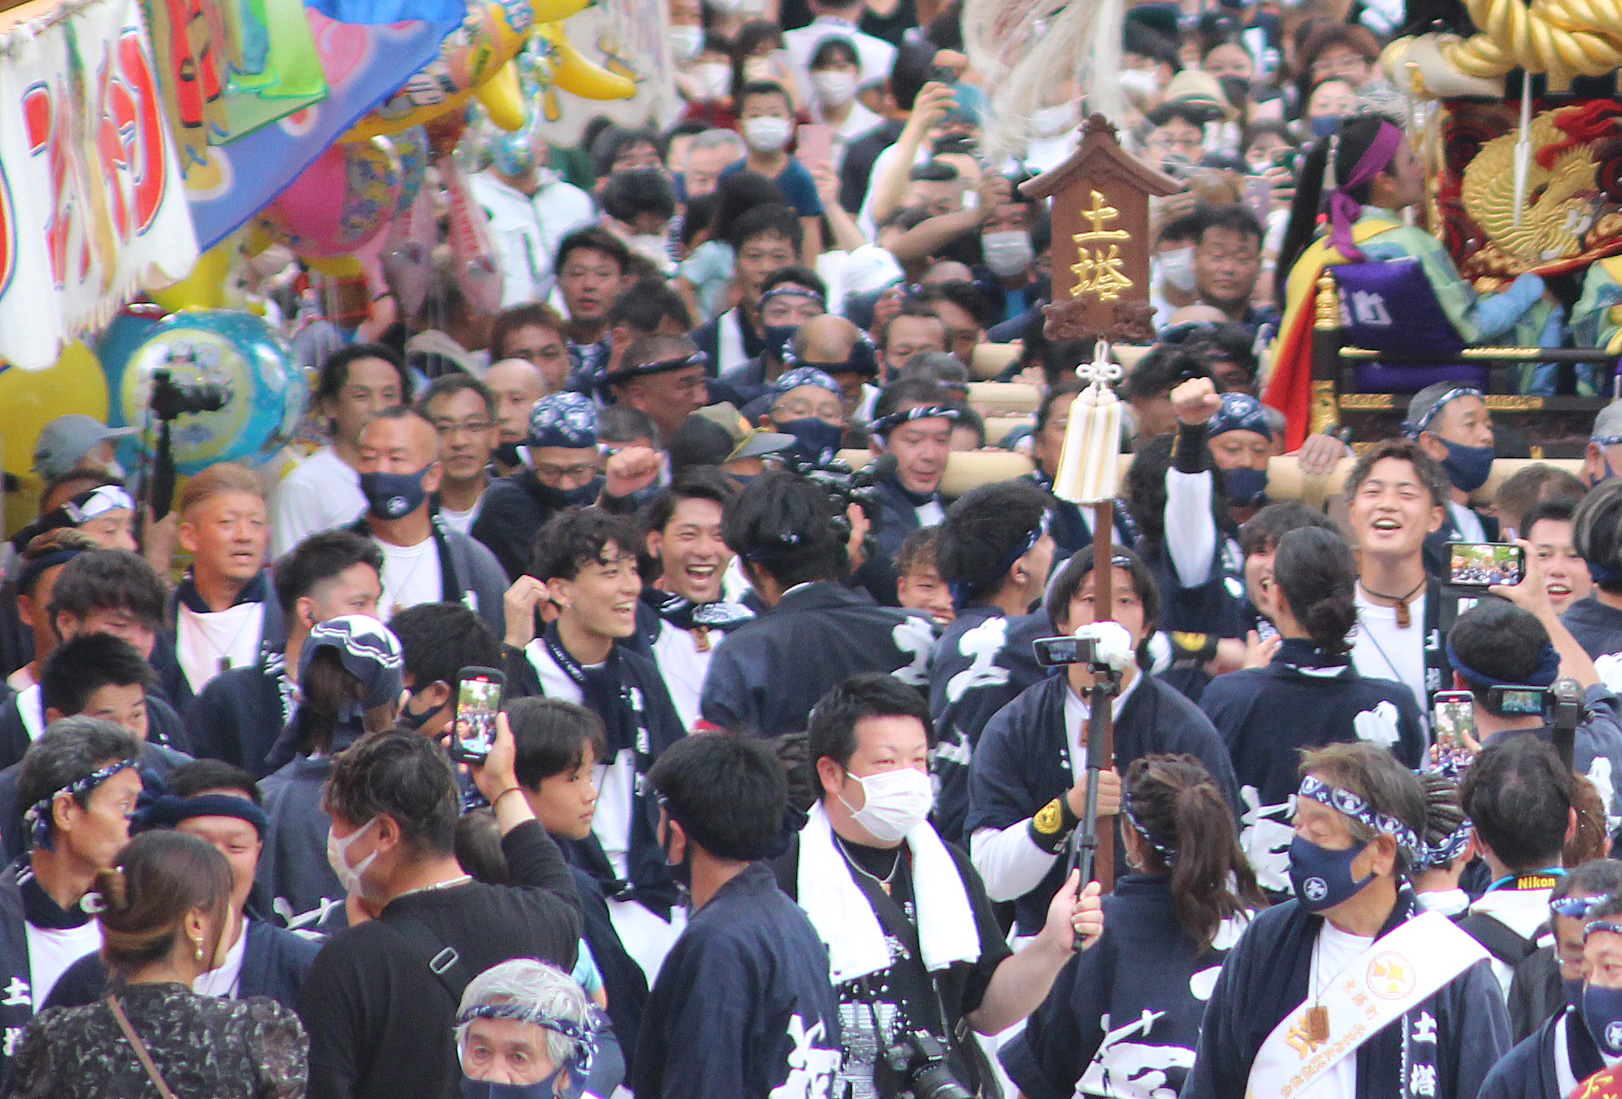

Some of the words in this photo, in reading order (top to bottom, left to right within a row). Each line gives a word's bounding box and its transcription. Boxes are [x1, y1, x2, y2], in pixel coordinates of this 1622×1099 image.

[1069, 189, 1134, 301] 土塔
[1517, 877, 1556, 890] Nikon
[1409, 1010, 1438, 1097] 土塔
